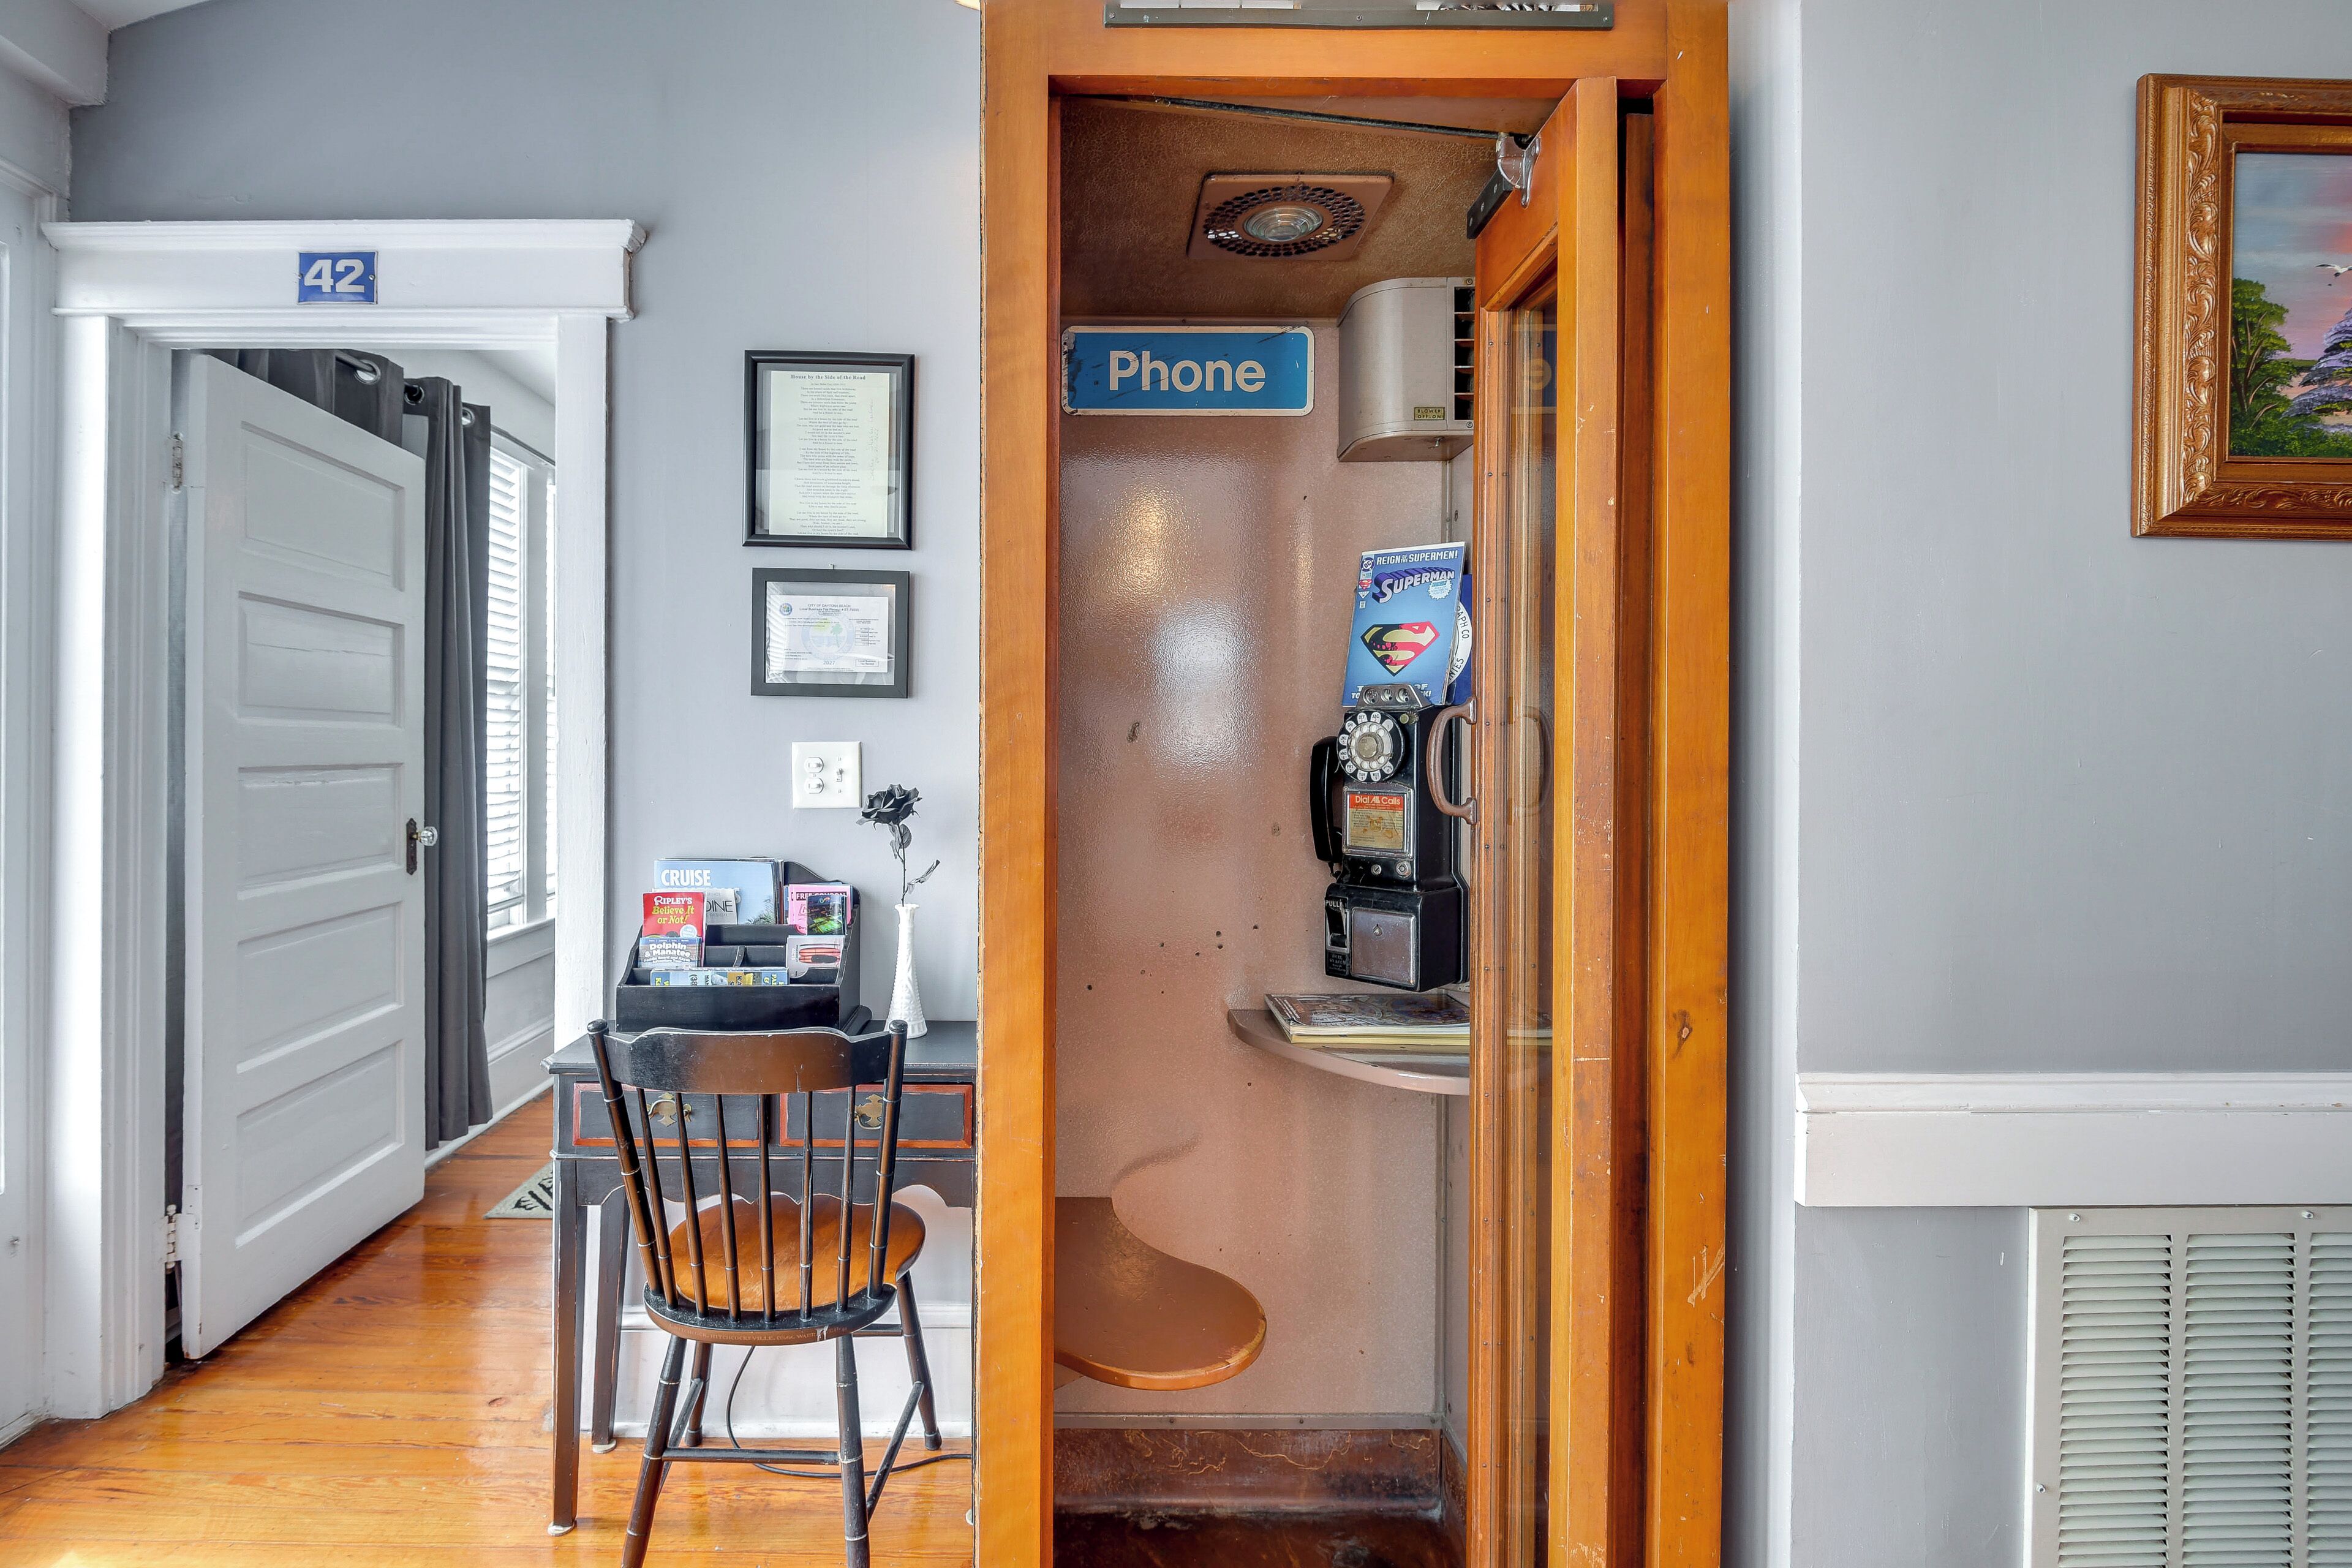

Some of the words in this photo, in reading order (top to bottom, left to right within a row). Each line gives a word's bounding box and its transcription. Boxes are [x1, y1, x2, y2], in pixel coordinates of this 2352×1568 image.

[304, 259, 365, 293] 42
[1109, 350, 1266, 393] Phone
[1376, 554, 1401, 565] REIGN
[1409, 549, 1458, 562] SUPERMEN!
[1373, 567, 1455, 603] SUPERMAN
[1355, 795, 1370, 804] Dial
[1381, 796, 1401, 805] Calls
[661, 869, 711, 886] CRUISE
[654, 896, 693, 905] RIPLEY'S
[652, 905, 685, 915] Believe
[685, 905, 695, 914] It
[668, 914, 689, 924] Not!
[649, 941, 687, 950] Dolphin
[652, 949, 691, 957] Manatee
